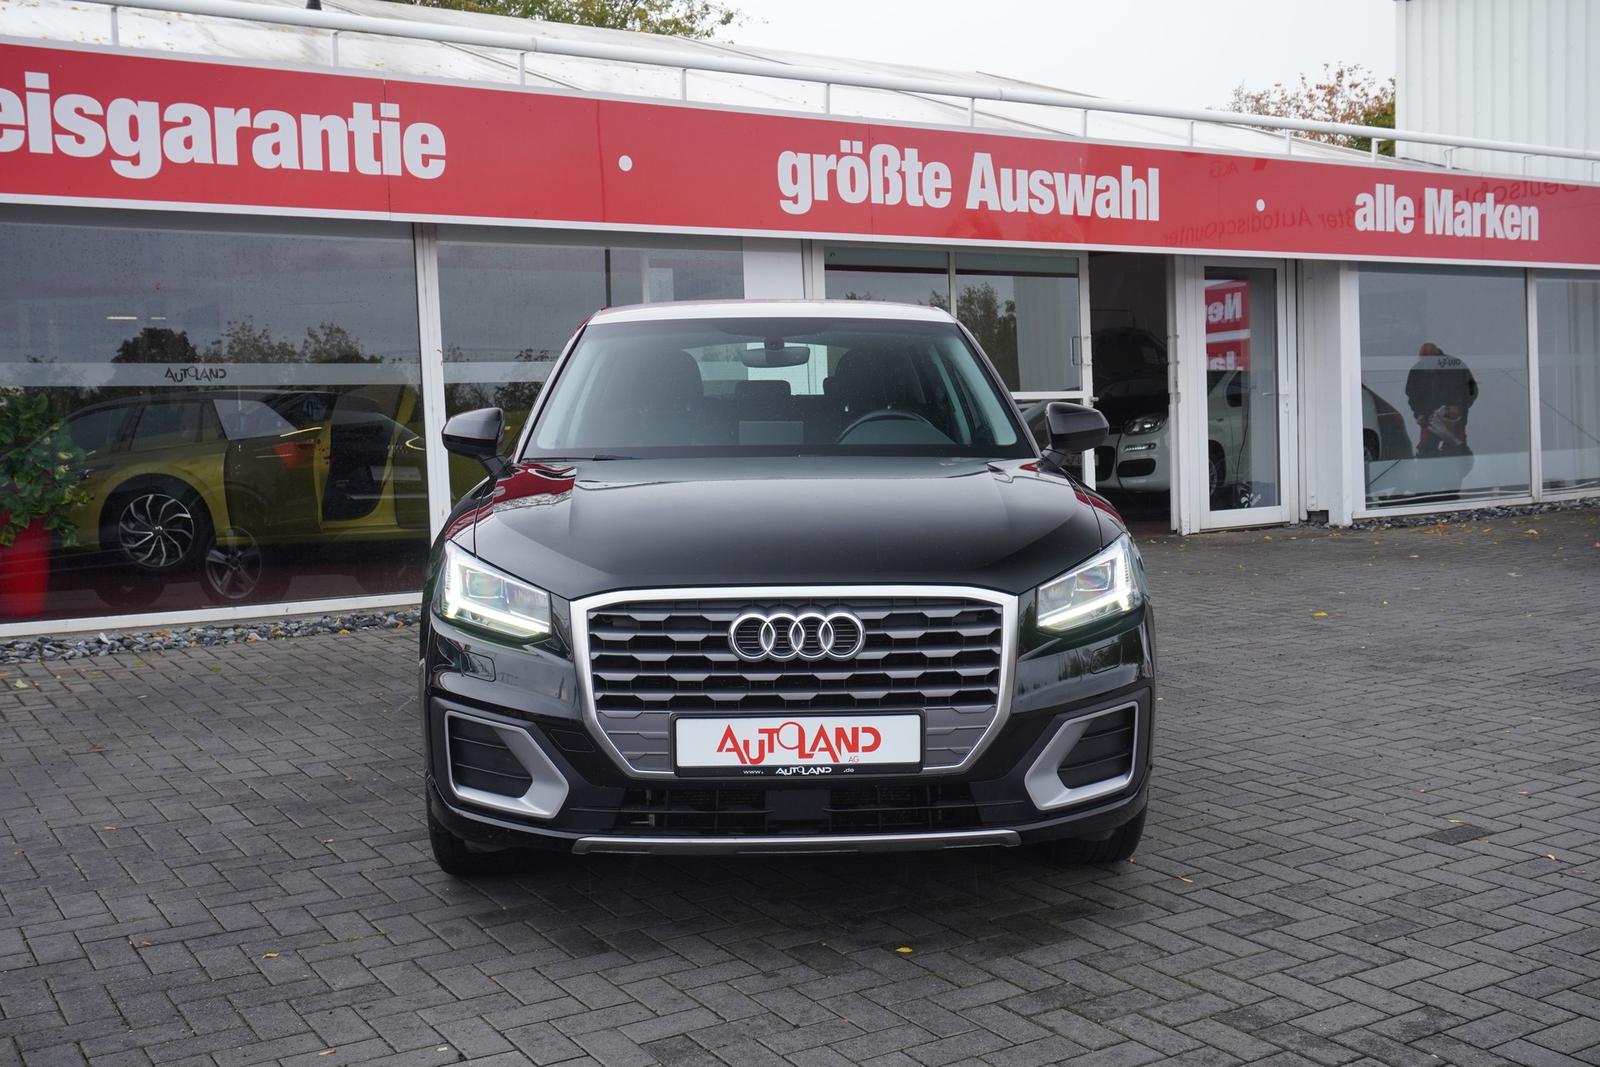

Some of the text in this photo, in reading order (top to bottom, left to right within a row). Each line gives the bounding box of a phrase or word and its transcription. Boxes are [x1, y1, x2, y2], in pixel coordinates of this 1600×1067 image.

[777, 140, 952, 214] größte
[966, 152, 1160, 222] Auswahl
[1355, 185, 1414, 233] alle
[1425, 188, 1539, 241] Marken
